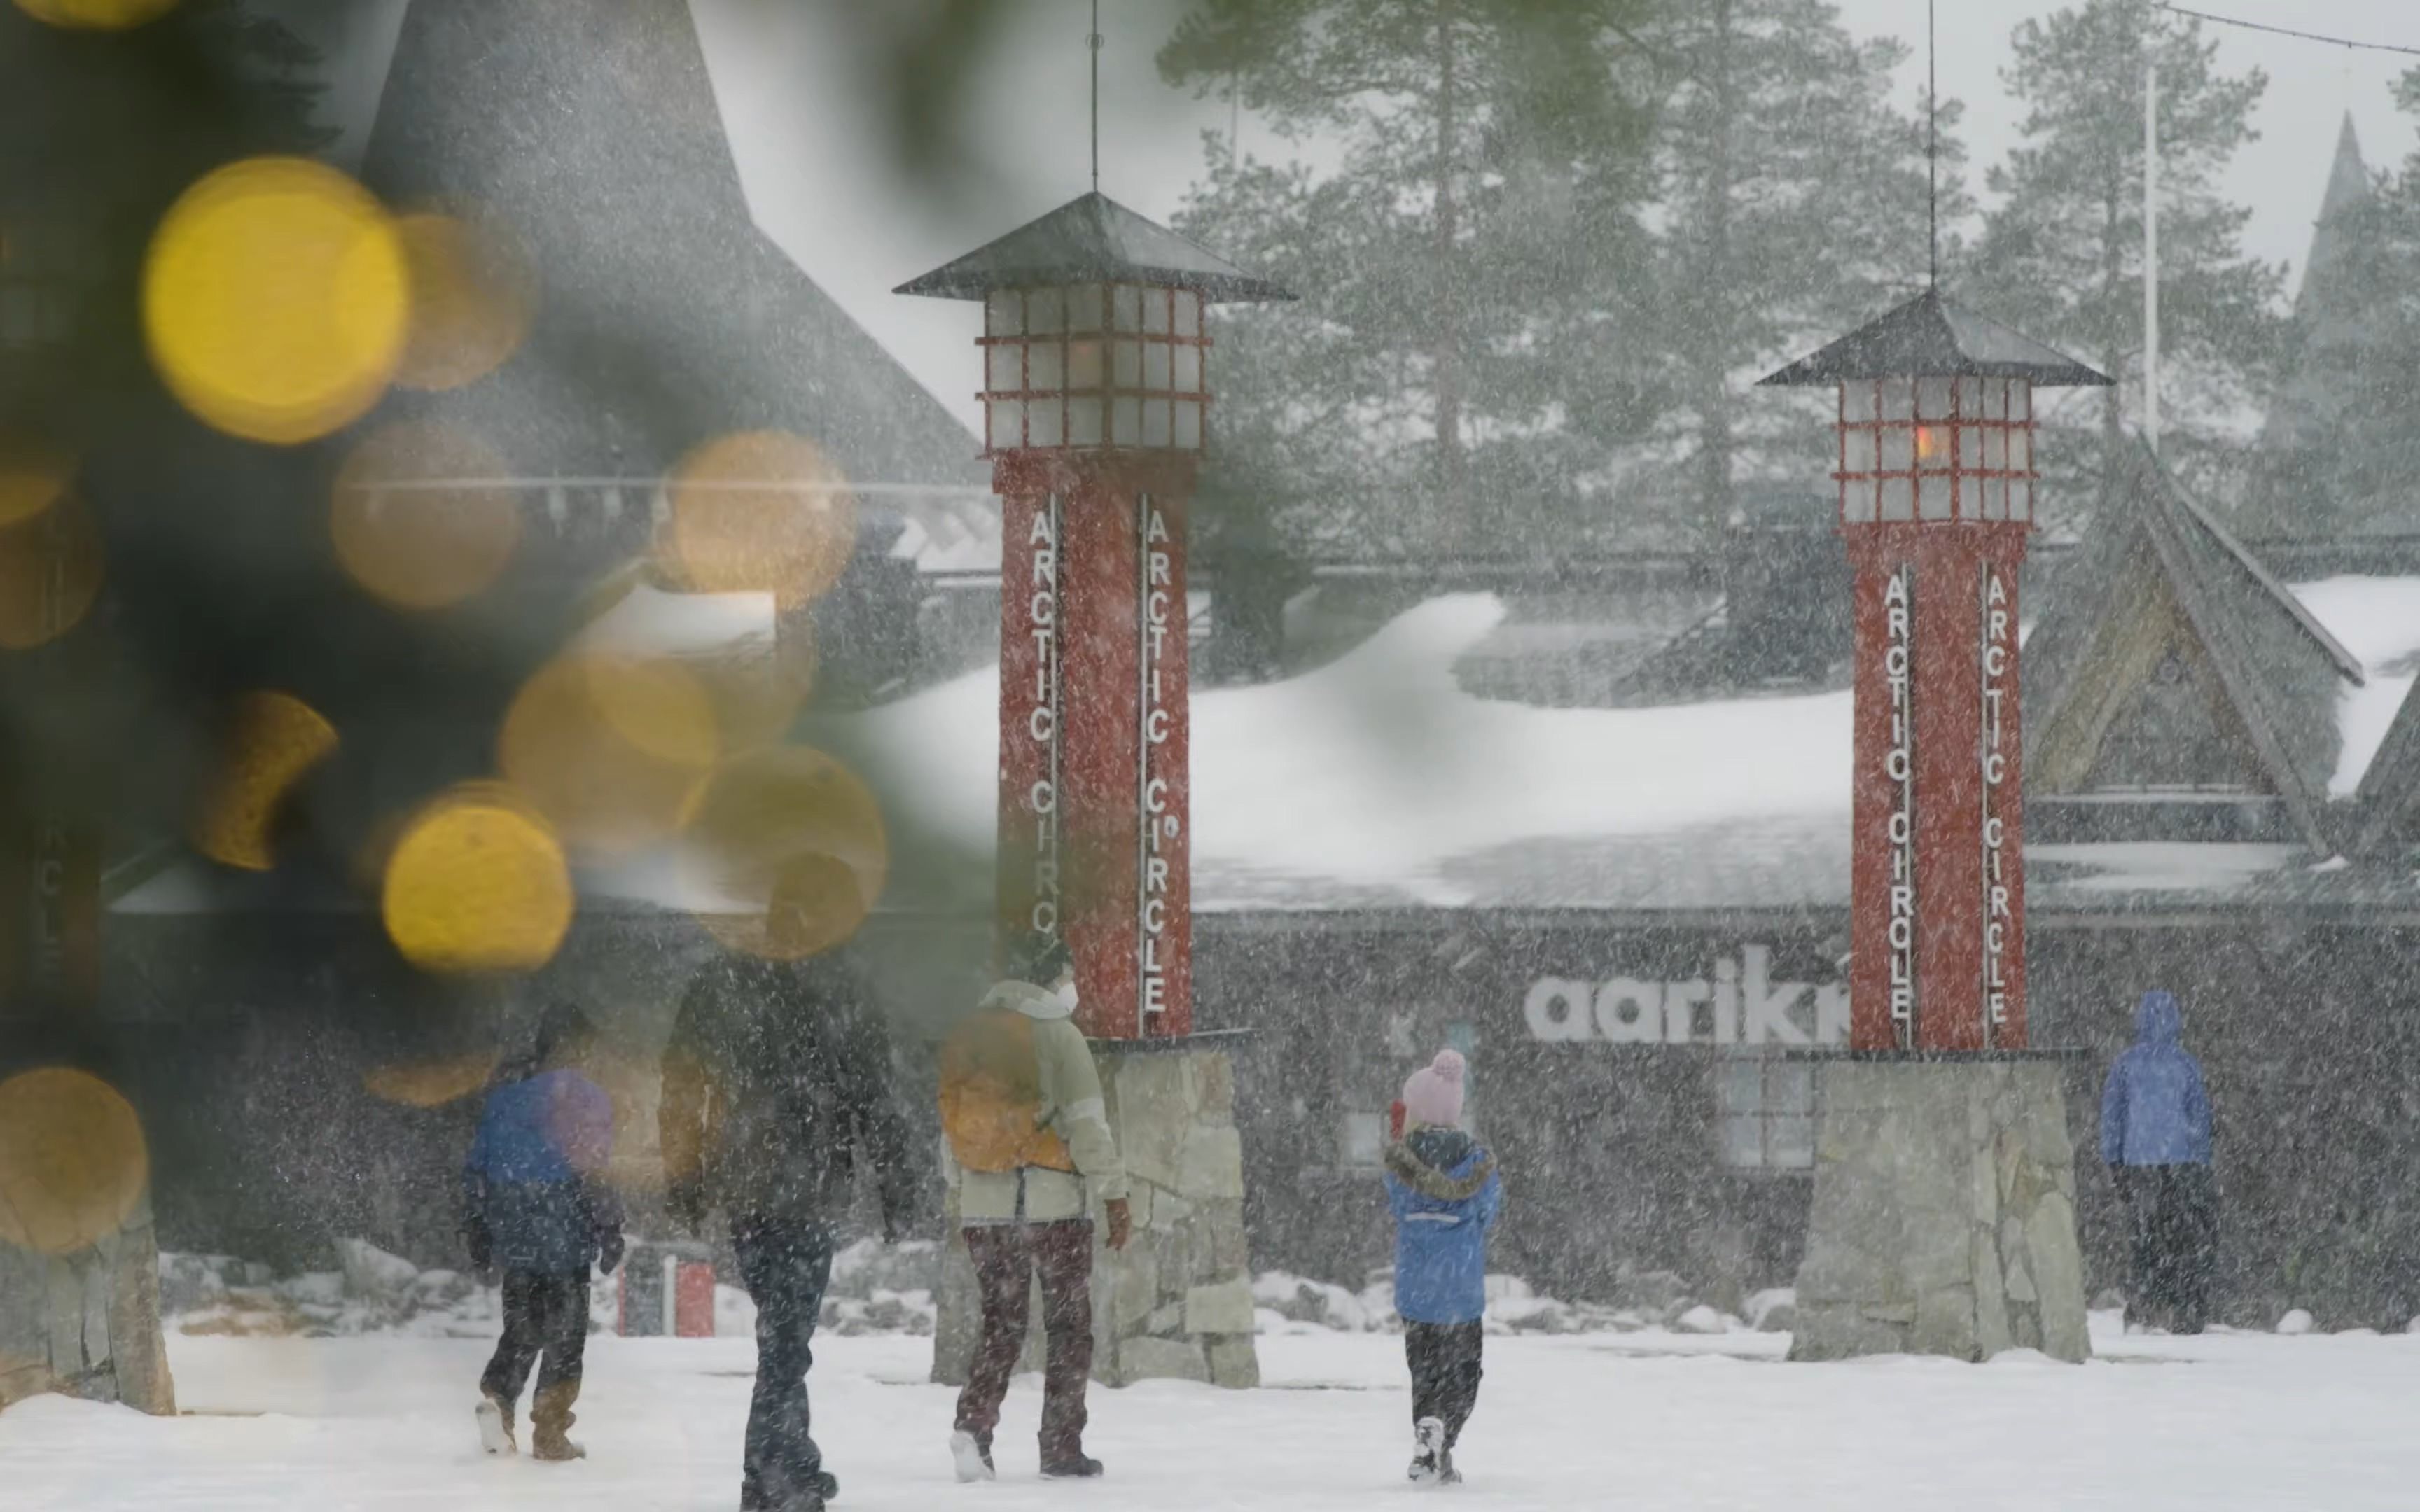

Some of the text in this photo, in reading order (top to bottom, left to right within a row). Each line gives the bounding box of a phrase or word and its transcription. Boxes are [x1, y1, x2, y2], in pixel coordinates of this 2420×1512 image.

[1029, 511, 1060, 934] ARCTIC CIRC
[1144, 510, 1171, 1012] ARCTIC CIRCLE
[1986, 575, 2009, 1023] ARCTIC CIRCLE
